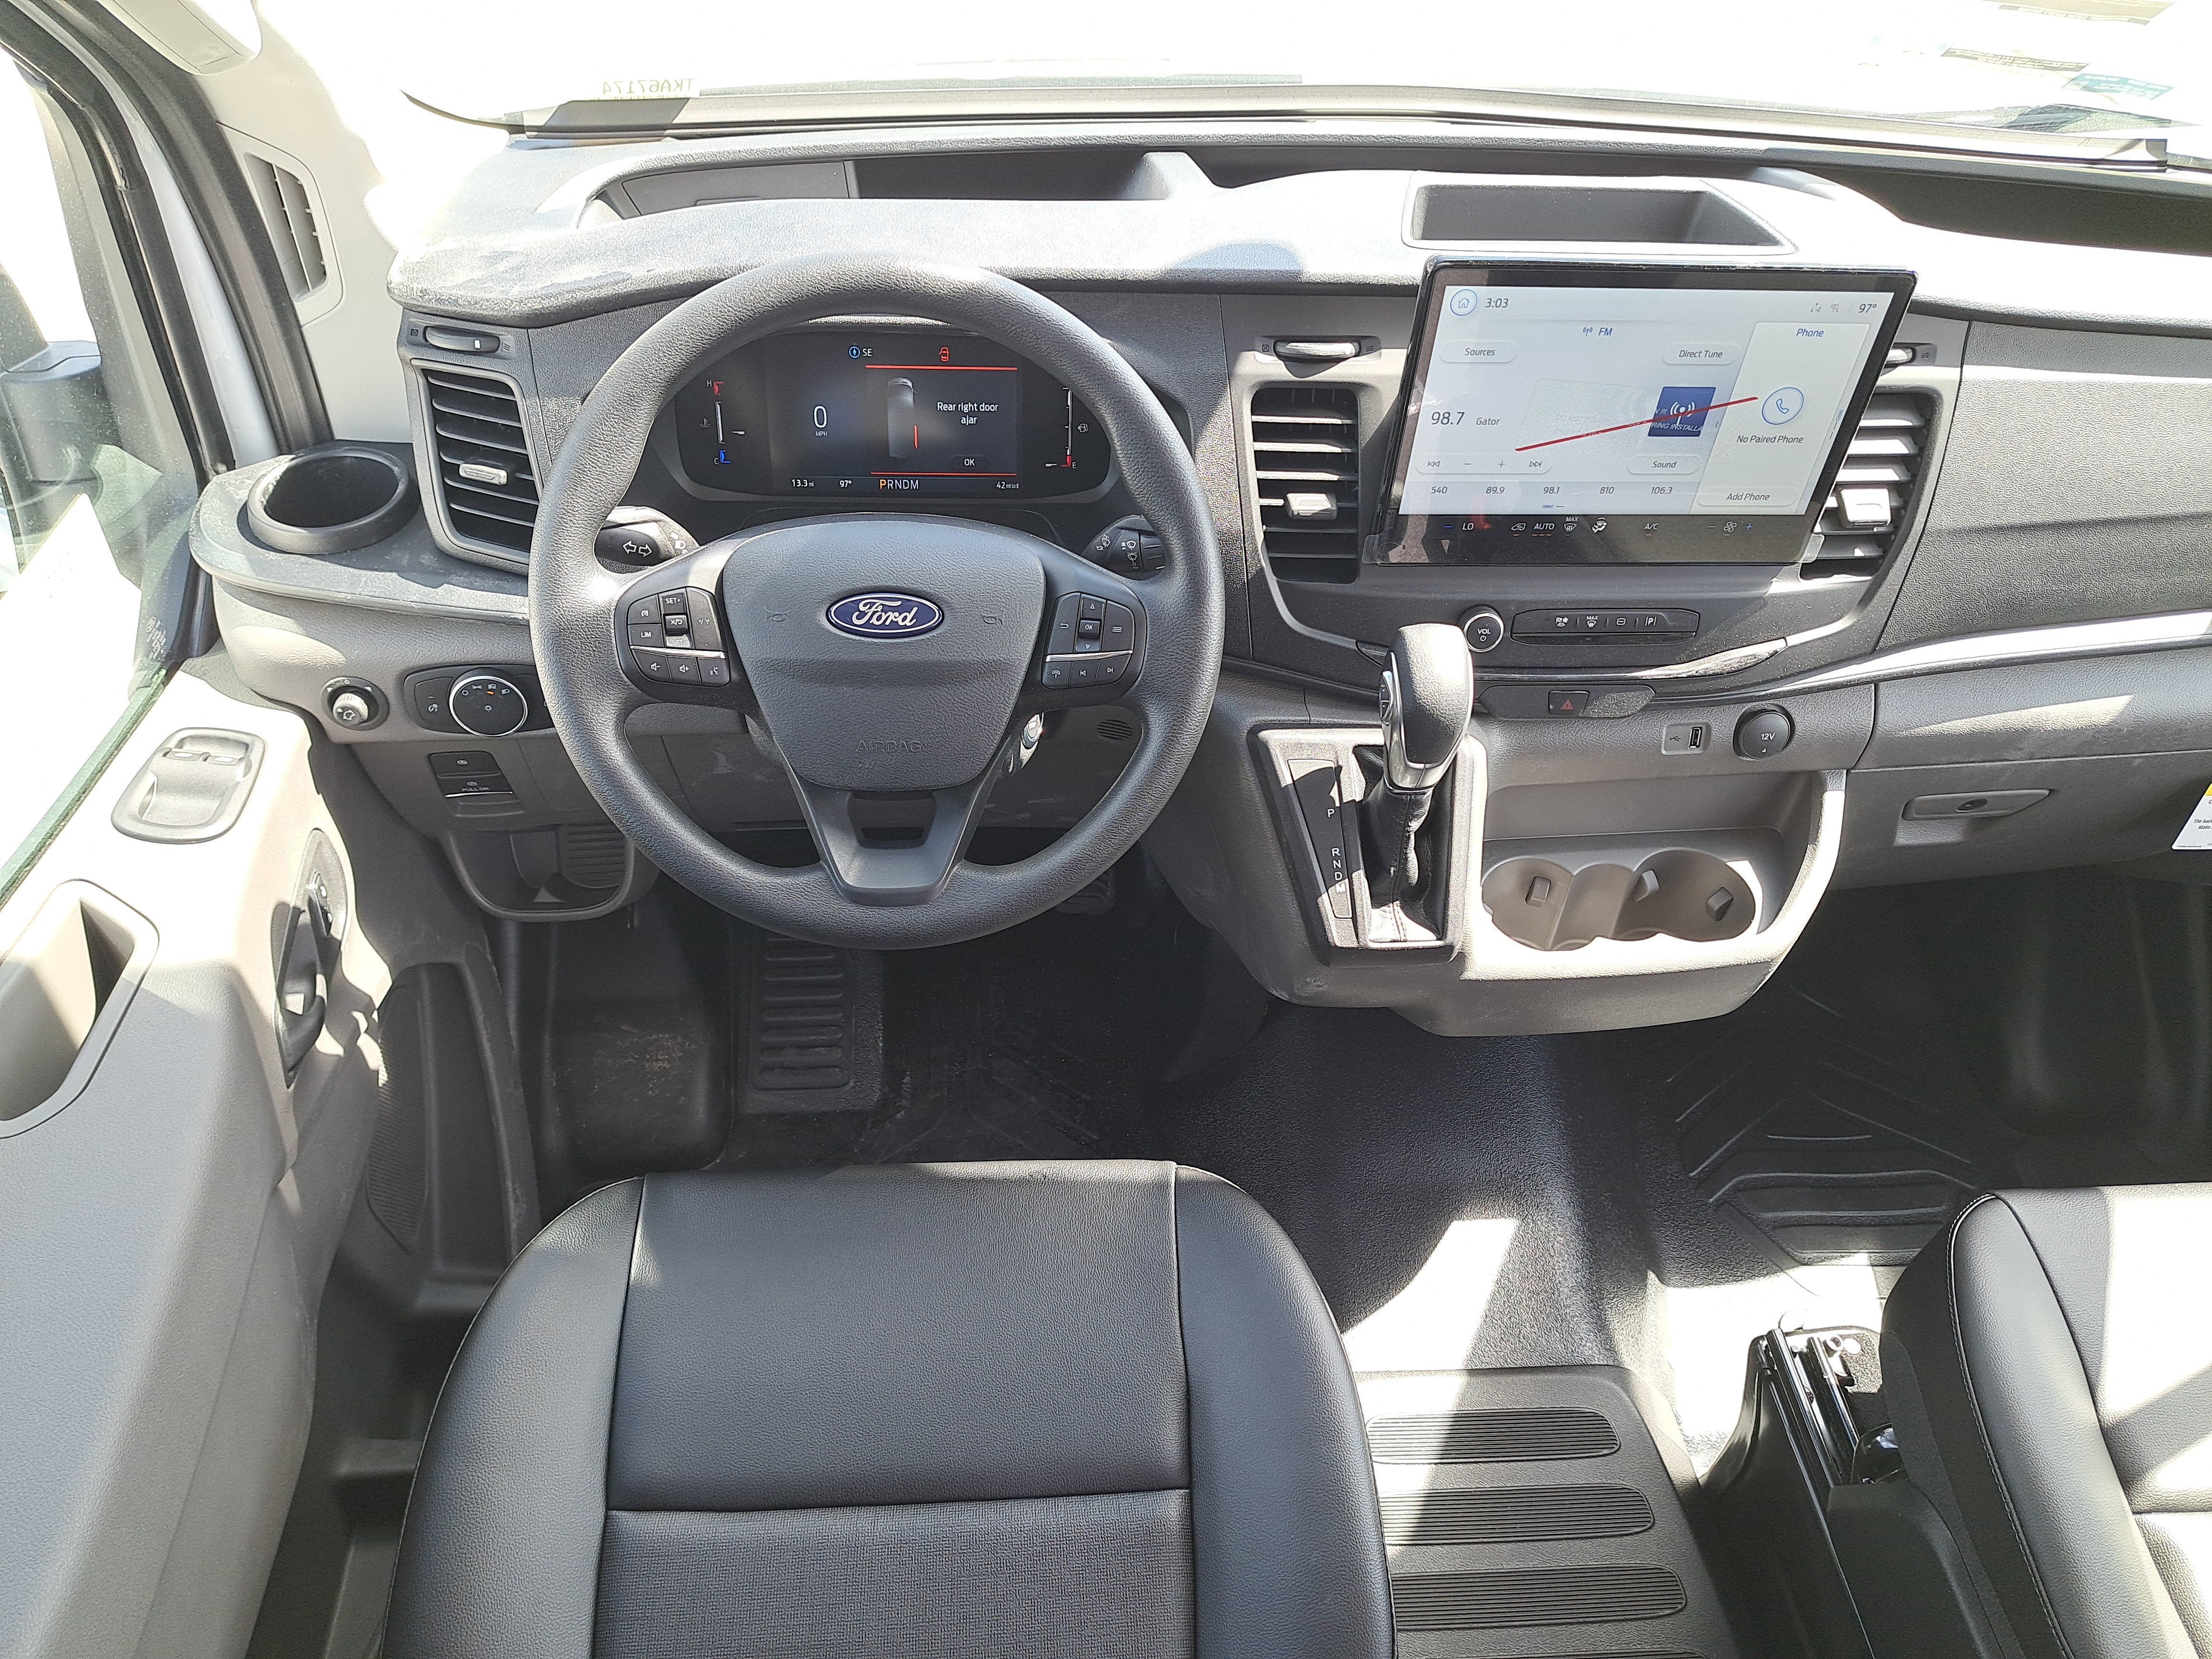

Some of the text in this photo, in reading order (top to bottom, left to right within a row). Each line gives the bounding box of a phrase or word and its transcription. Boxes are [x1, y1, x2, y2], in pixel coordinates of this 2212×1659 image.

[1485, 298, 1508, 308] 3:03
[1598, 327, 1613, 336] FM
[1796, 328, 1825, 338] Phone
[863, 348, 873, 357] SE
[1464, 348, 1495, 356] Sources
[1679, 350, 1723, 358] Direct Tune
[937, 402, 998, 412] Rear right door
[813, 406, 827, 428] 0
[961, 415, 978, 426] ajar
[1431, 411, 1500, 425] 98.7 Gator
[1749, 435, 1777, 443] Paired
[1777, 435, 1803, 443] Phone
[964, 458, 975, 466] OK
[792, 479, 807, 487] 13.3
[1744, 493, 1770, 501] Phone
[1462, 522, 1474, 531] LO
[852, 599, 918, 626] Ford
[1760, 732, 1776, 741] 12V
[857, 740, 922, 753] AIRBAG
[1327, 808, 1335, 818] P
[1332, 848, 1340, 856] R
[1333, 860, 1341, 869] N
[1335, 872, 1342, 881] D
[1336, 884, 1345, 893] M
